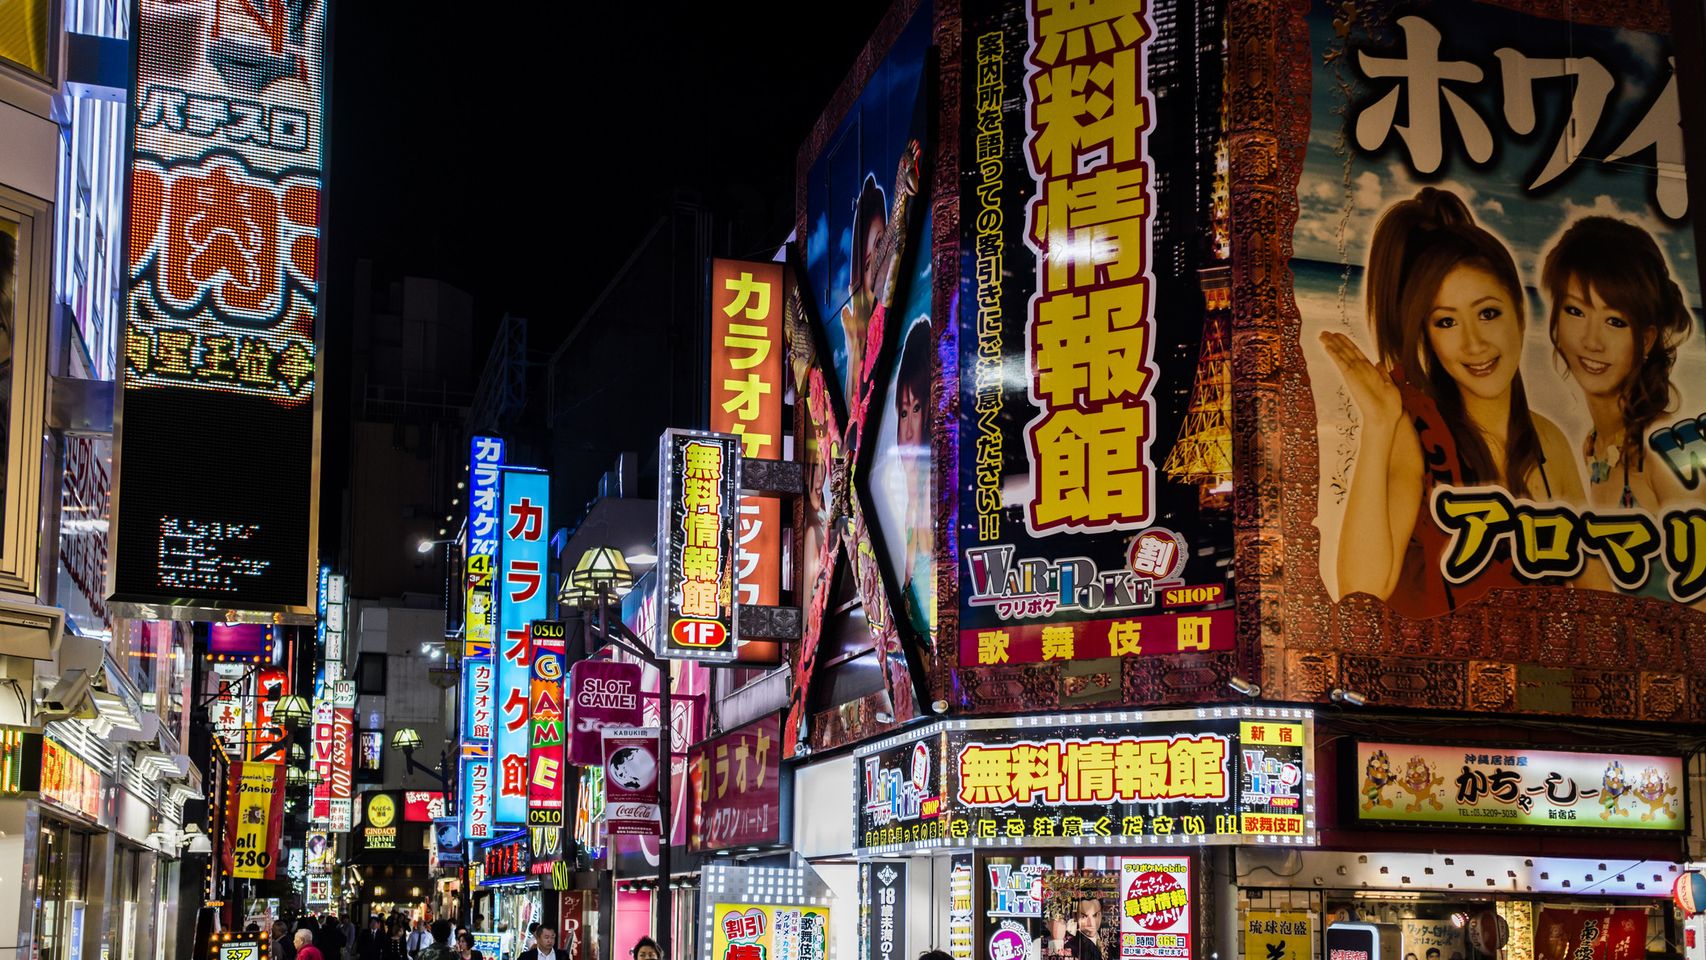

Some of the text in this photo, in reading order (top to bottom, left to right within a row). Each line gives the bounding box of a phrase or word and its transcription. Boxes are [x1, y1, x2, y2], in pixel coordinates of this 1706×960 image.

[138, 85, 310, 152] パチスロ
[1356, 15, 1690, 220] ホワイ
[1030, 0, 1156, 535] 無料情報館
[721, 272, 773, 459] カラオケ
[682, 441, 721, 617] 無料情報館
[1134, 536, 1176, 577] 割
[1165, 586, 1222, 606] SHOP
[998, 599, 1056, 618] ワリポケ
[533, 625, 564, 638] OSLO
[682, 622, 717, 644] 1F
[977, 616, 1213, 665] 歌舞伎町
[502, 497, 545, 799] カラオケ館
[583, 678, 632, 695] SLOT
[473, 666, 491, 738] カラオケ館
[577, 692, 637, 710] GAME!
[532, 654, 562, 791] GAME
[334, 711, 352, 764] Access
[1250, 726, 1292, 743] 新宿
[700, 728, 769, 802] カラオケ
[1464, 753, 1528, 766] 沖縄居酒屋
[331, 767, 350, 798] 100
[957, 738, 1231, 805] 無料情報館
[1456, 765, 1599, 813] かちゃーしー
[472, 765, 488, 837] カラオケ館
[1272, 797, 1297, 807] SHOP
[530, 811, 560, 822] OSLO
[1244, 817, 1301, 833] 歌舞伎町
[1548, 809, 1577, 820] 新宿店
[236, 833, 257, 849] all
[1130, 882, 1180, 898] スマートフォンで
[1135, 875, 1163, 888] ケータイ
[1124, 889, 1187, 917] 最新情報
[726, 916, 765, 939] 割引
[1138, 908, 1180, 927] をゲット!!
[1249, 921, 1307, 935] 琉球泡盛
[1123, 935, 1185, 946] 24時間 365日
